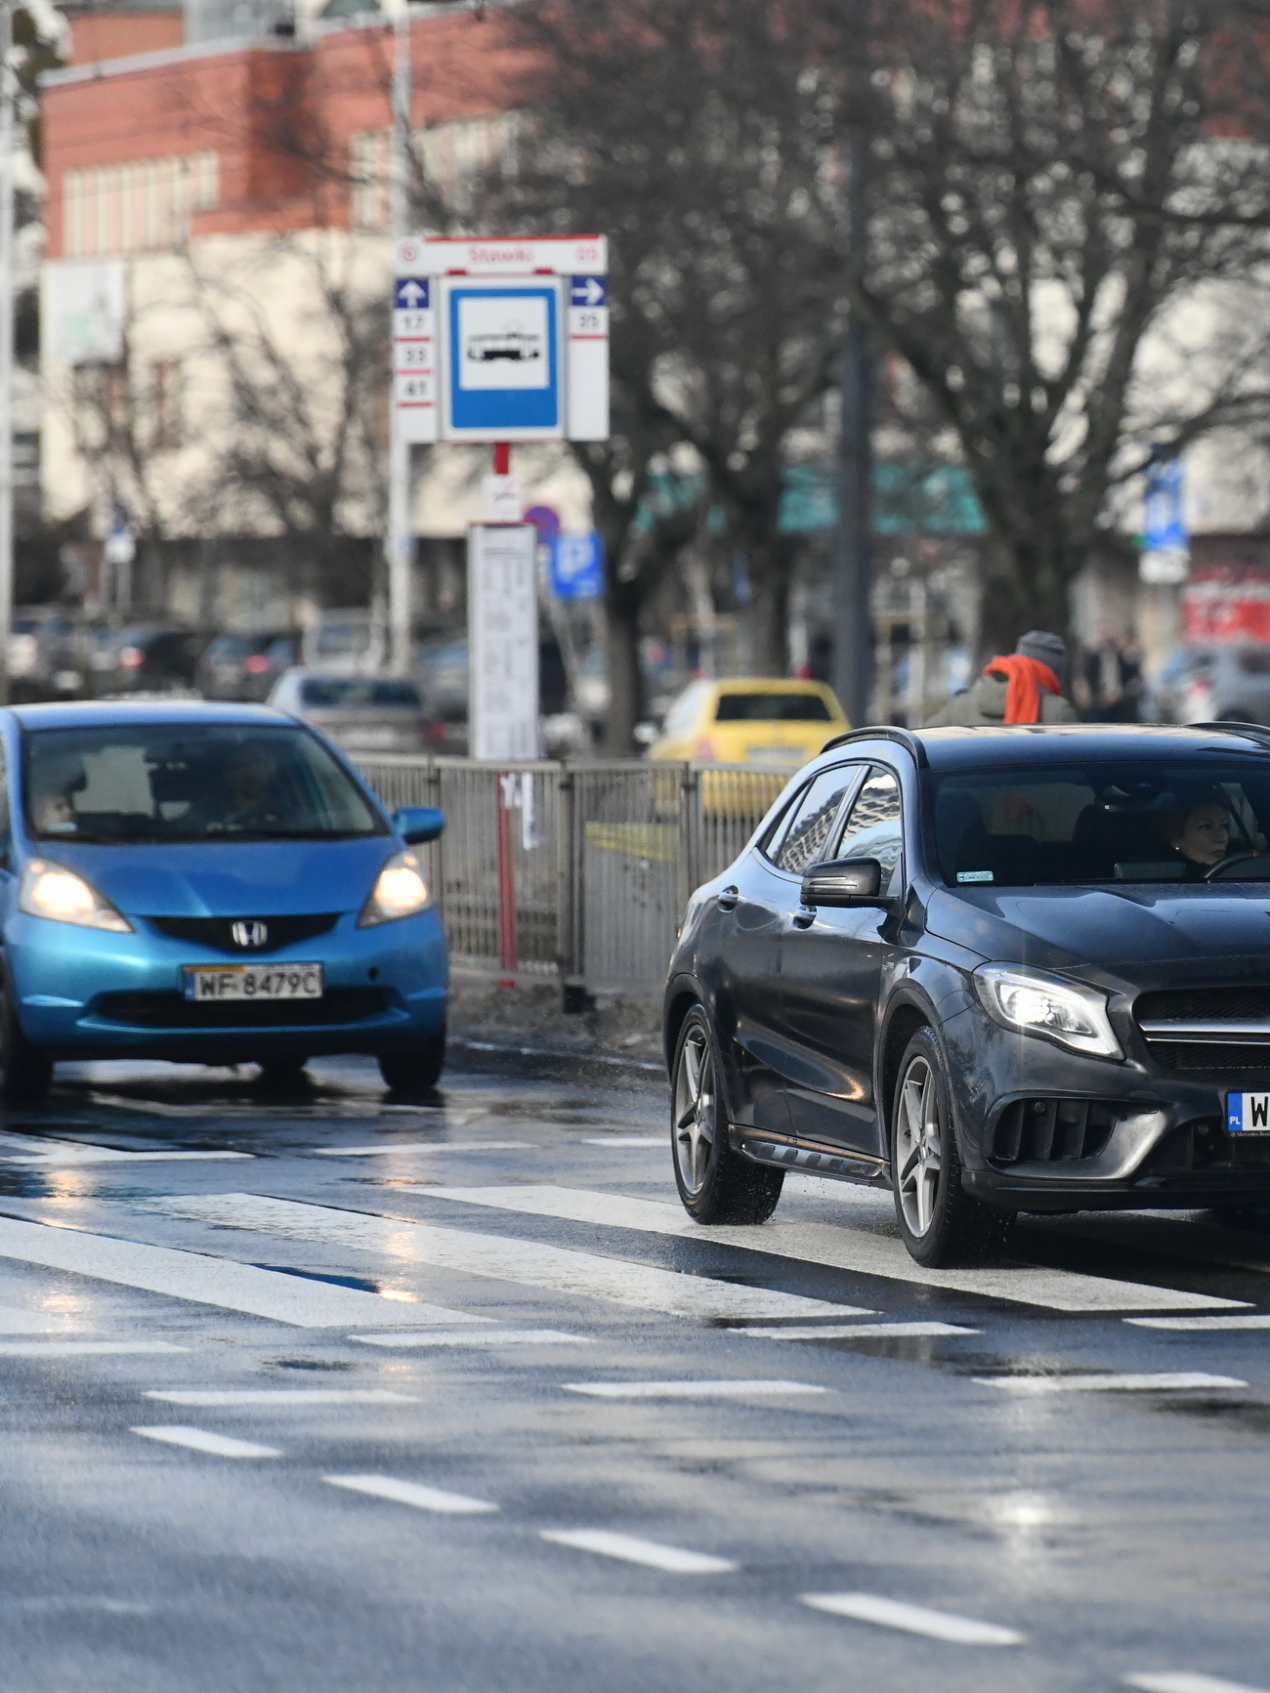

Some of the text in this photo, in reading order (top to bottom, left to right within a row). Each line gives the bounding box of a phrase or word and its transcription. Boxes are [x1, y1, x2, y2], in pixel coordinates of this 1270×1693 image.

[404, 314, 424, 330] 17
[200, 971, 317, 996] WF 8479C
[1229, 1116, 1241, 1126] PL
